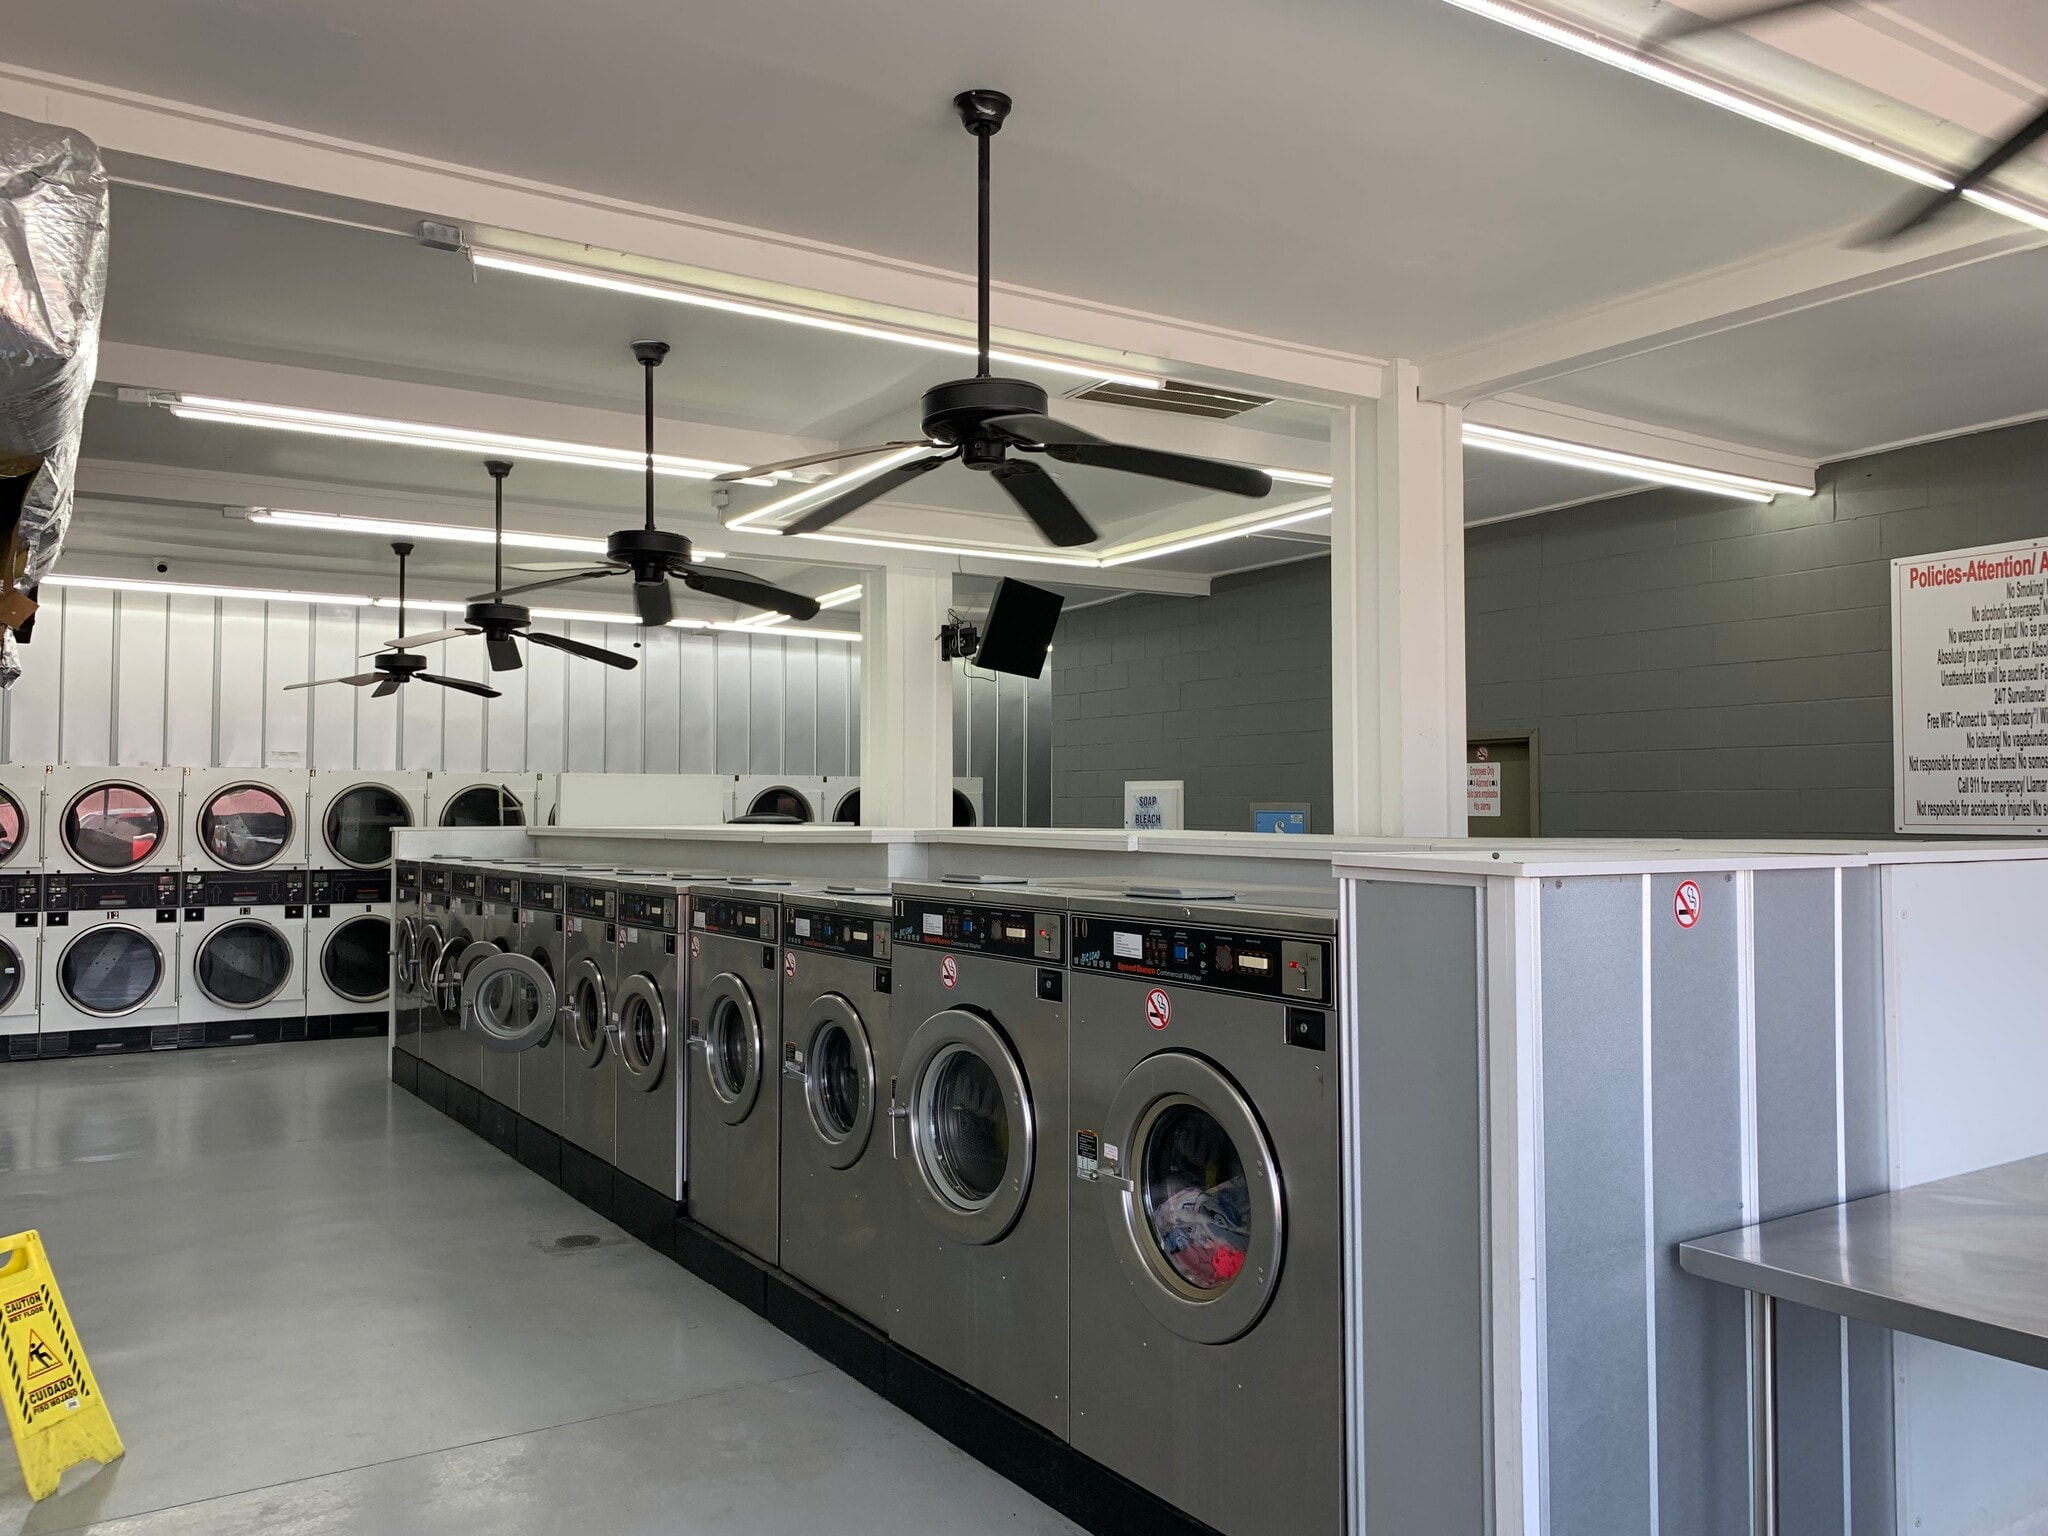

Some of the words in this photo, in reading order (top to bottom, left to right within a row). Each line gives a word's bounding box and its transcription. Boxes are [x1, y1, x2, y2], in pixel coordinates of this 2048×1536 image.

[2006, 582, 2015, 599] No
[1972, 605, 1980, 622] No
[1981, 603, 2007, 621] alcoholic
[1949, 628, 1957, 644] No
[1957, 629, 1983, 646] weapons
[1985, 624, 1991, 640] of
[1992, 627, 2002, 644] any
[2020, 621, 2028, 637] No
[2030, 624, 2037, 637] se
[1937, 647, 1967, 667] Absolutely
[1968, 651, 1976, 662] no
[1977, 645, 1998, 666] playing
[1999, 643, 2012, 660] with
[1941, 668, 1973, 686] Unattended
[1974, 668, 1986, 684] kids
[1987, 667, 1997, 683] will
[1999, 666, 2006, 682] be
[1927, 713, 1939, 729] Free
[1956, 711, 1980, 727] Connect
[1981, 711, 1987, 726] to
[1967, 732, 1975, 748] No
[2003, 730, 2011, 747] No
[1909, 755, 1919, 771] Not
[1920, 755, 1951, 775] responsible
[1952, 754, 1960, 770] for
[1961, 754, 1979, 770] stolen
[1980, 758, 1986, 770] or
[1987, 754, 1998, 770] lost
[2018, 752, 2027, 769] No
[1958, 777, 1969, 793] Call
[1970, 777, 1980, 793] 911
[1981, 776, 1989, 793] for
[1139, 796, 1157, 807] SOAP
[1917, 800, 1927, 816] Not
[1928, 800, 1960, 820] responsible
[1961, 799, 1969, 816] for
[1971, 799, 1998, 816] accidents
[2000, 804, 2006, 816] or
[2033, 799, 2042, 816] No
[1135, 814, 1161, 824] BLEACH
[1074, 918, 1088, 939] 10
[1156, 969, 1183, 980] Commercial
[1184, 972, 1202, 981] Washer
[5, 1293, 41, 1314] CAUTION
[9, 1313, 22, 1323] WET
[24, 1306, 44, 1319] FLOOR
[29, 1377, 74, 1404] CUIDADO
[33, 1403, 49, 1416] PISO
[50, 1390, 78, 1408] MOJADO
